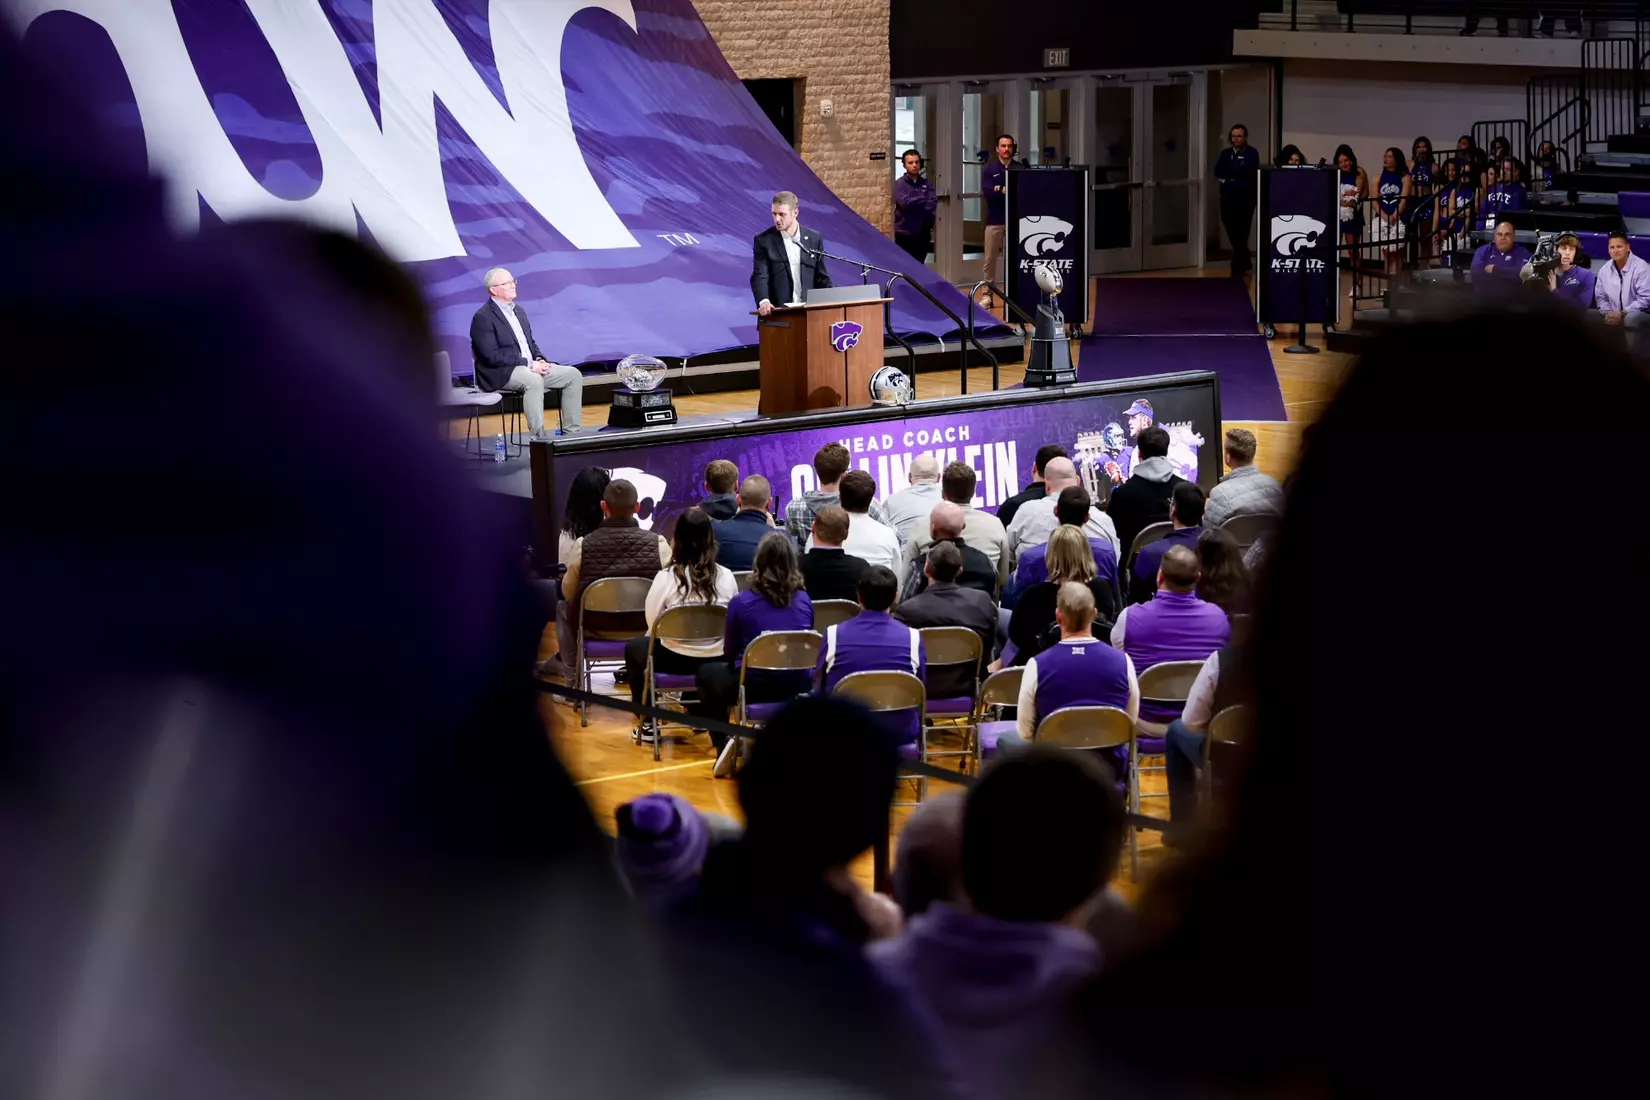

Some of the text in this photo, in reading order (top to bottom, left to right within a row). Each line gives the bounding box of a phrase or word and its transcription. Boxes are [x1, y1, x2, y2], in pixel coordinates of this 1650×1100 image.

[1049, 50, 1067, 66] EXIT
[656, 232, 700, 247] TM
[1020, 259, 1074, 269] K-STATE
[838, 425, 970, 453] HEAD COACH
